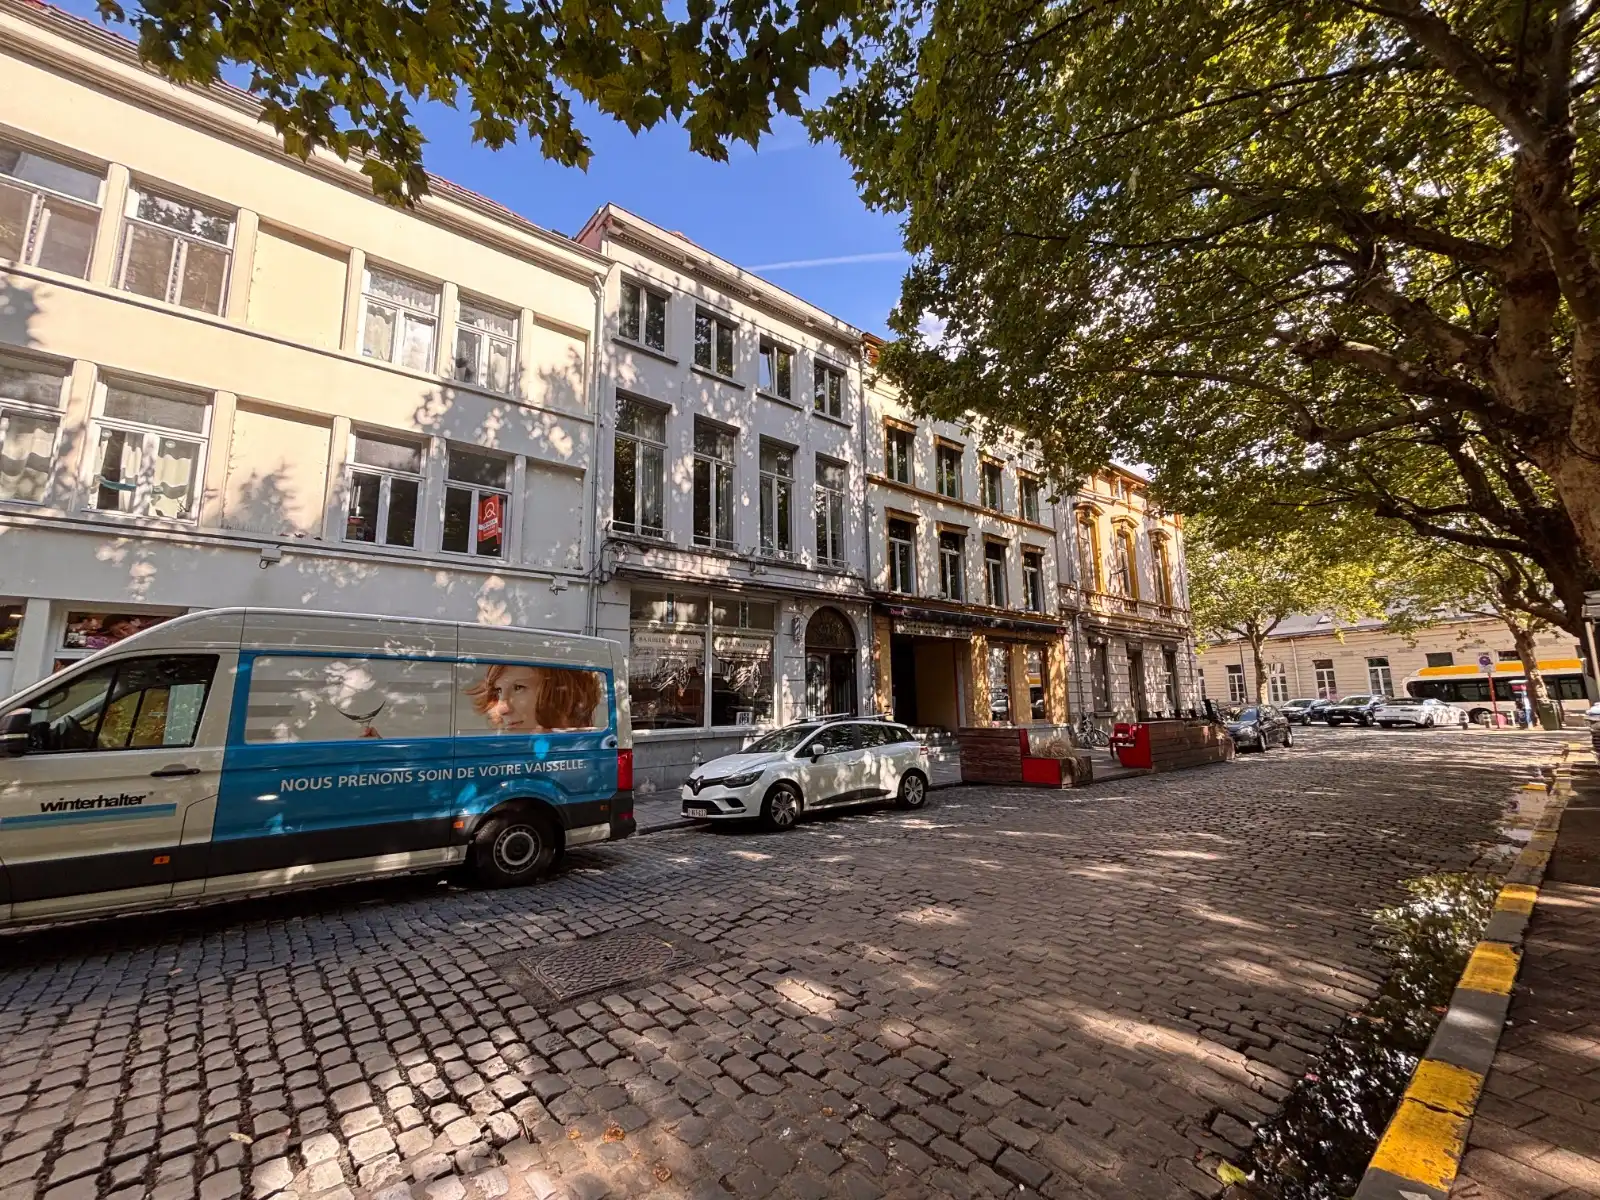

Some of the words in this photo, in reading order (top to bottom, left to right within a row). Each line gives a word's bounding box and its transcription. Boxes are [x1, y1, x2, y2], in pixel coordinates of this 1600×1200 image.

[280, 776, 333, 792] NOUS
[338, 771, 413, 788] PRENONS
[417, 768, 453, 782] SOIN
[457, 767, 475, 779] DE
[479, 763, 522, 777] VOTRE
[525, 759, 587, 774] VAISSELLE.
[40, 793, 147, 812] winterhalter
